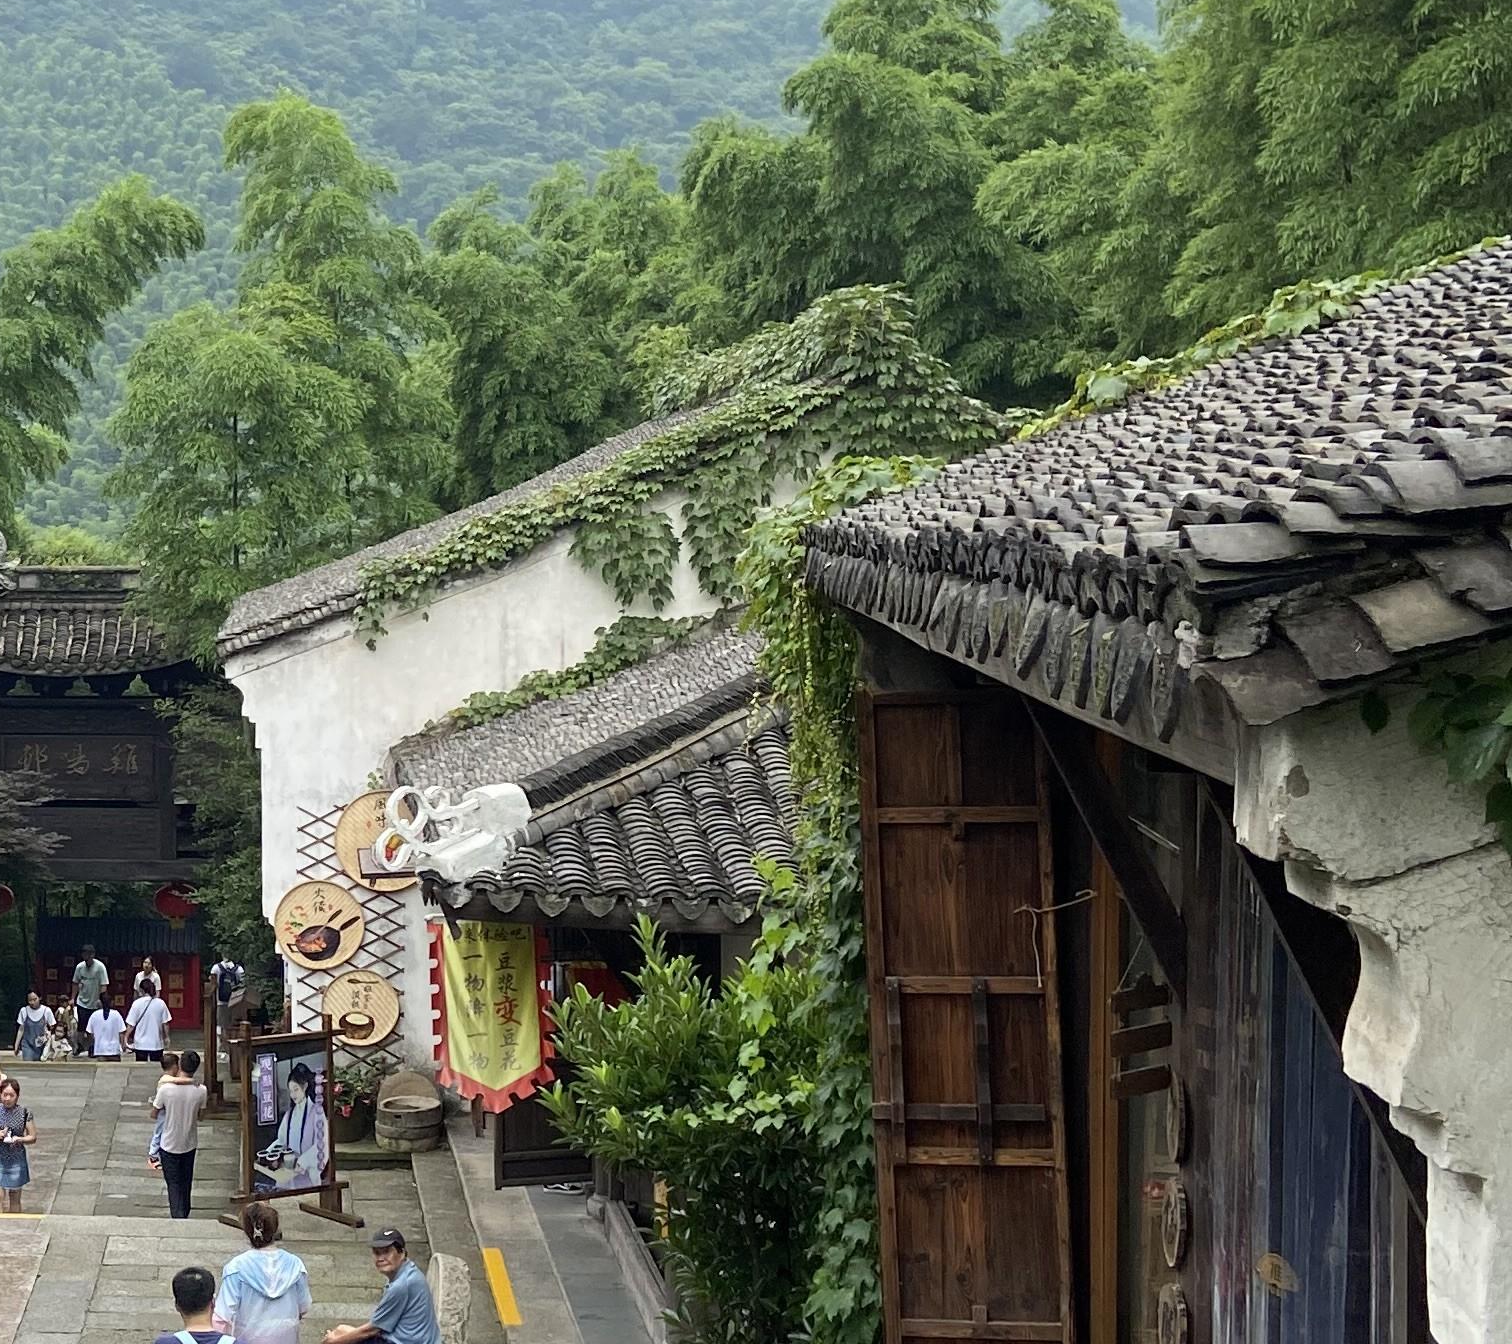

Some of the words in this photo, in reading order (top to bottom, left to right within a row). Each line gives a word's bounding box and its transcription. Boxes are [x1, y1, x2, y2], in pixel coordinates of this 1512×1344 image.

[494, 951, 522, 1071] 豆浆变豆花
